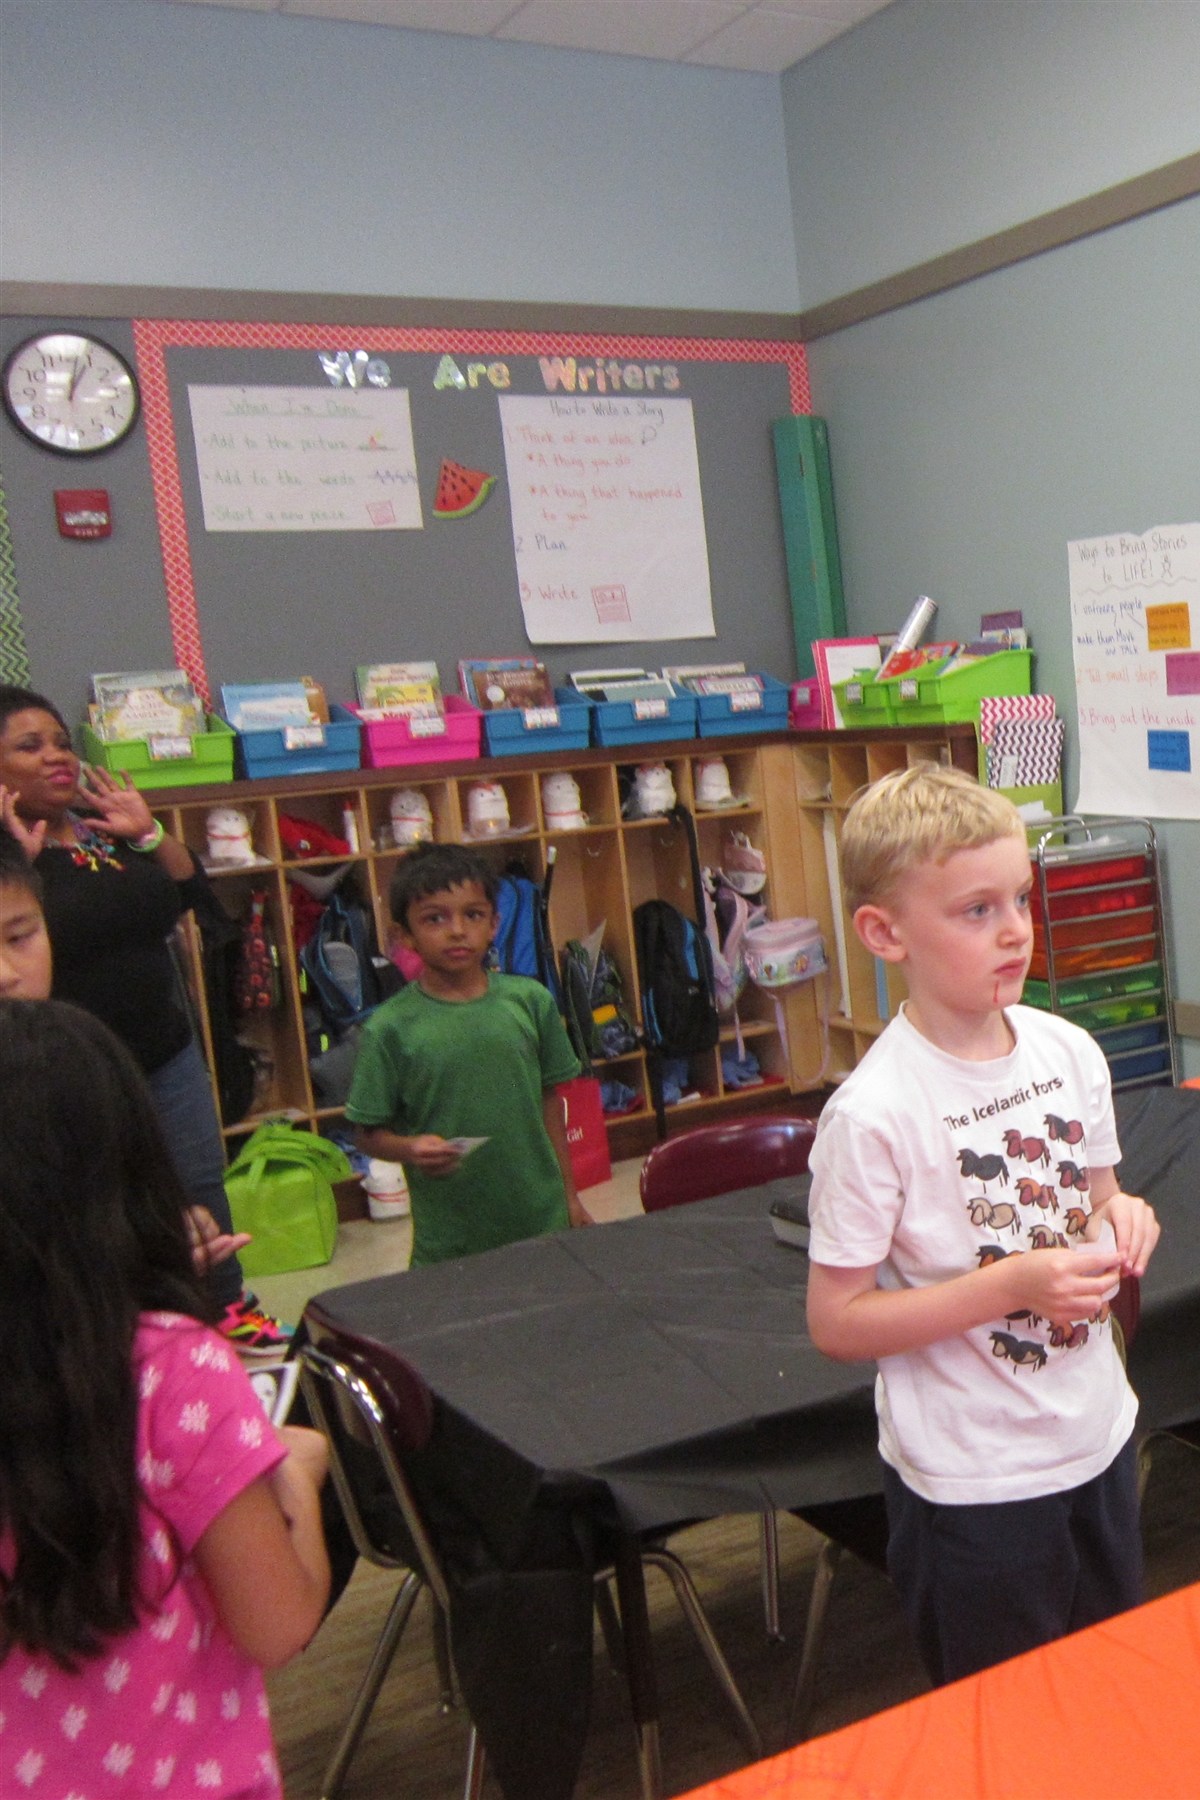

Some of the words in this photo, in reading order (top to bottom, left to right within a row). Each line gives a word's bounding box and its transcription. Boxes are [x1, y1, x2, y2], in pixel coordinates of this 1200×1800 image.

[318, 349, 392, 389] We
[433, 354, 512, 391] Are
[538, 356, 681, 393] Writers
[1119, 537, 1148, 562] Bring
[1151, 532, 1188, 551] Stories
[942, 1114, 970, 1131] The
